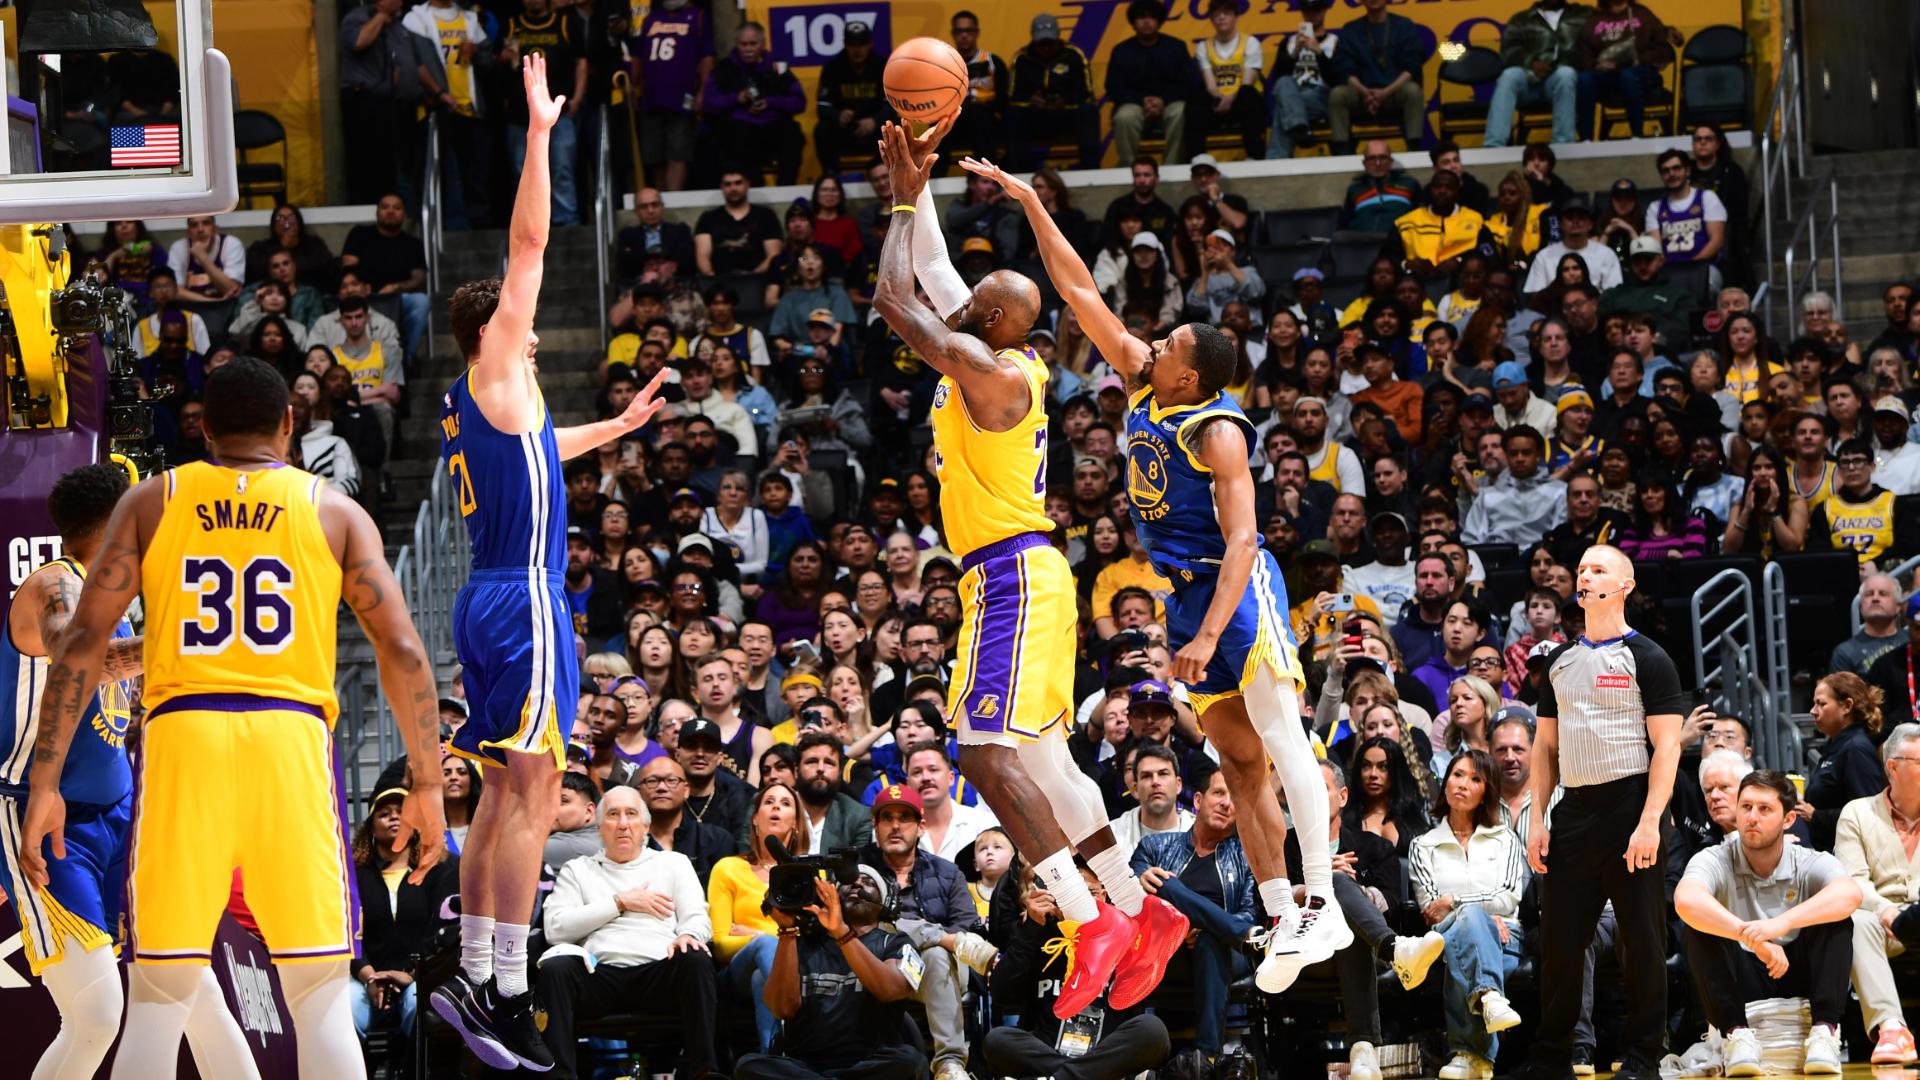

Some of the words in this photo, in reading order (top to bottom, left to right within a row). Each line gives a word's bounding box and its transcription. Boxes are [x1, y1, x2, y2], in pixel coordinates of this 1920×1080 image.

[649, 37, 677, 61] 16
[1667, 234, 1696, 253] 23
[1150, 435, 1171, 461] STATE
[1148, 460, 1158, 480] 8
[196, 499, 285, 533] SMART
[1139, 501, 1171, 521] RIORS
[1831, 515, 1883, 534] LAKERS
[9, 536, 63, 586] GET
[180, 555, 296, 656] 36
[1597, 677, 1629, 687] Emirates
[91, 712, 125, 749] WARR
